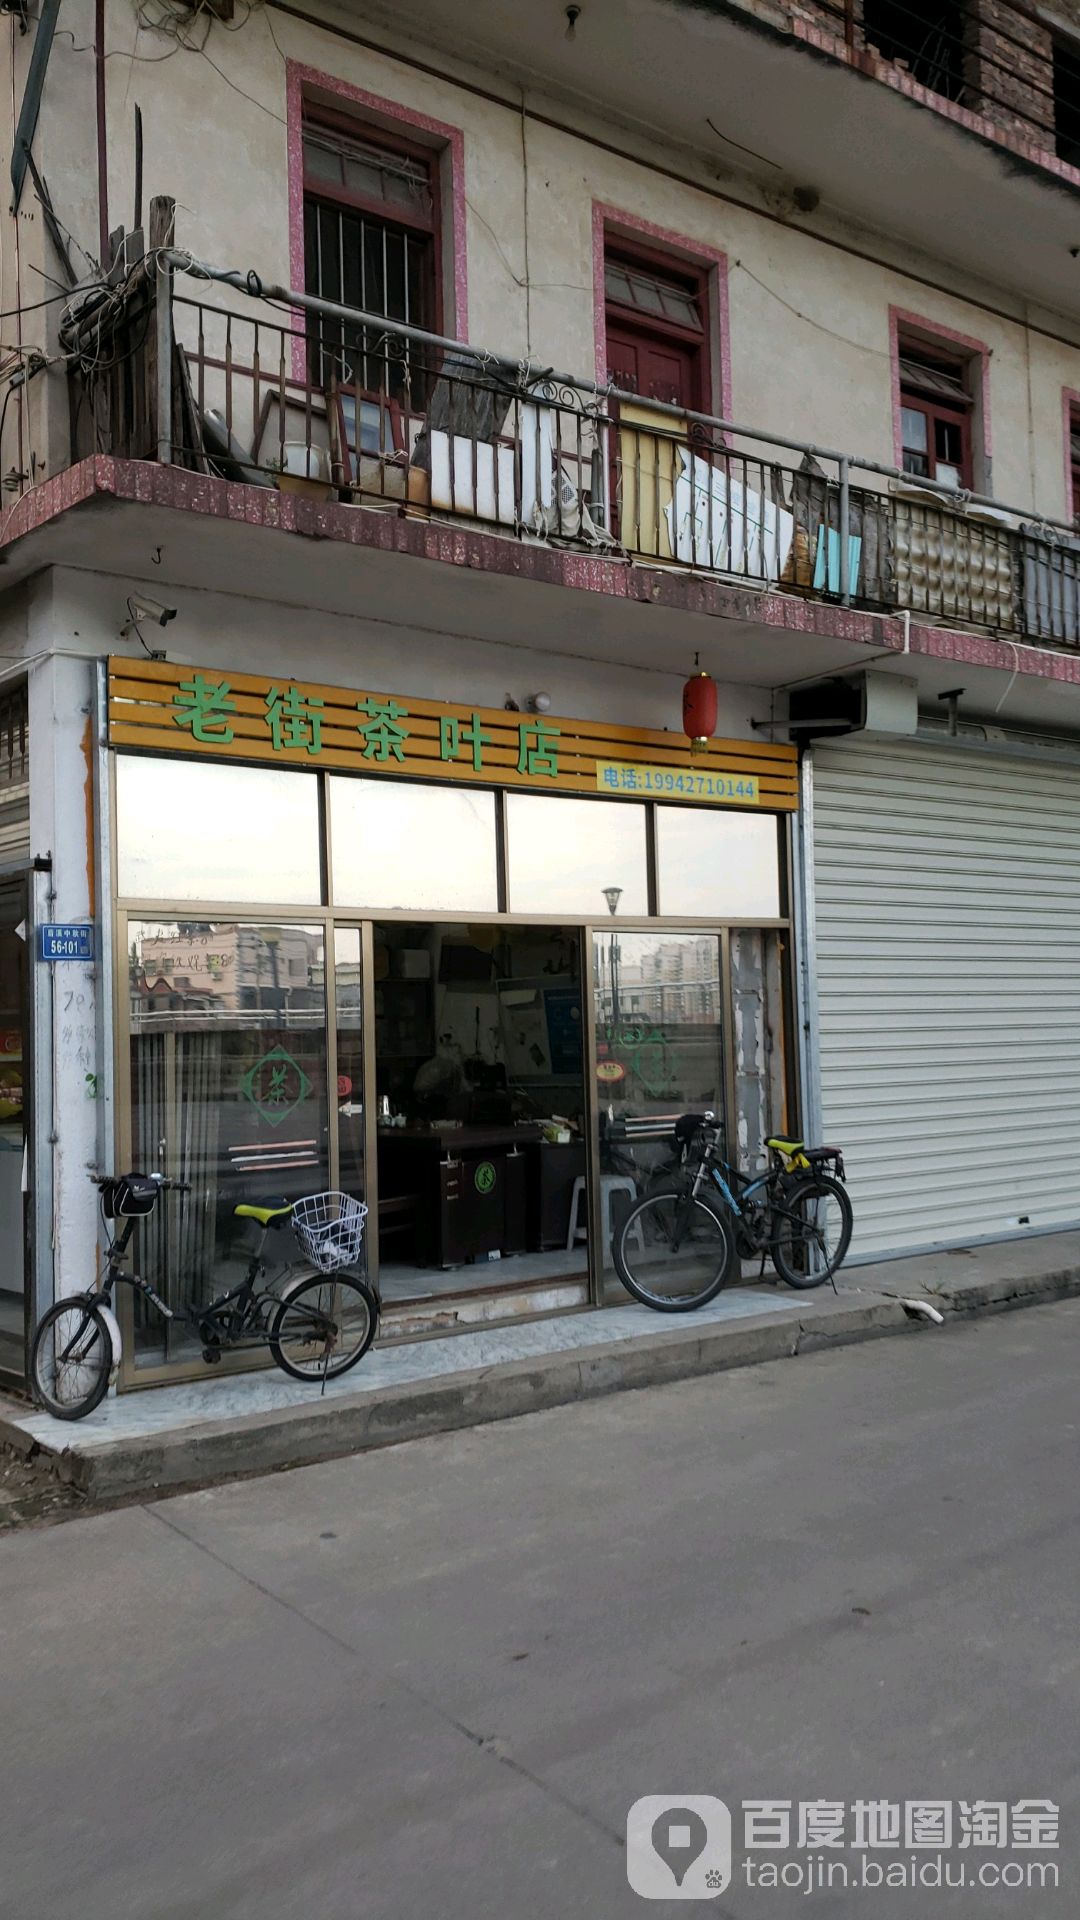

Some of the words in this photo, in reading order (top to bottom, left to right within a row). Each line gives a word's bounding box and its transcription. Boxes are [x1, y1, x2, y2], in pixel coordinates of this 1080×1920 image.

[174, 675, 562, 777] 老街茶叶店
[603, 767, 756, 800] 电话:19942710144
[51, 940, 78, 954] 56-101
[261, 1064, 293, 1106] 茶
